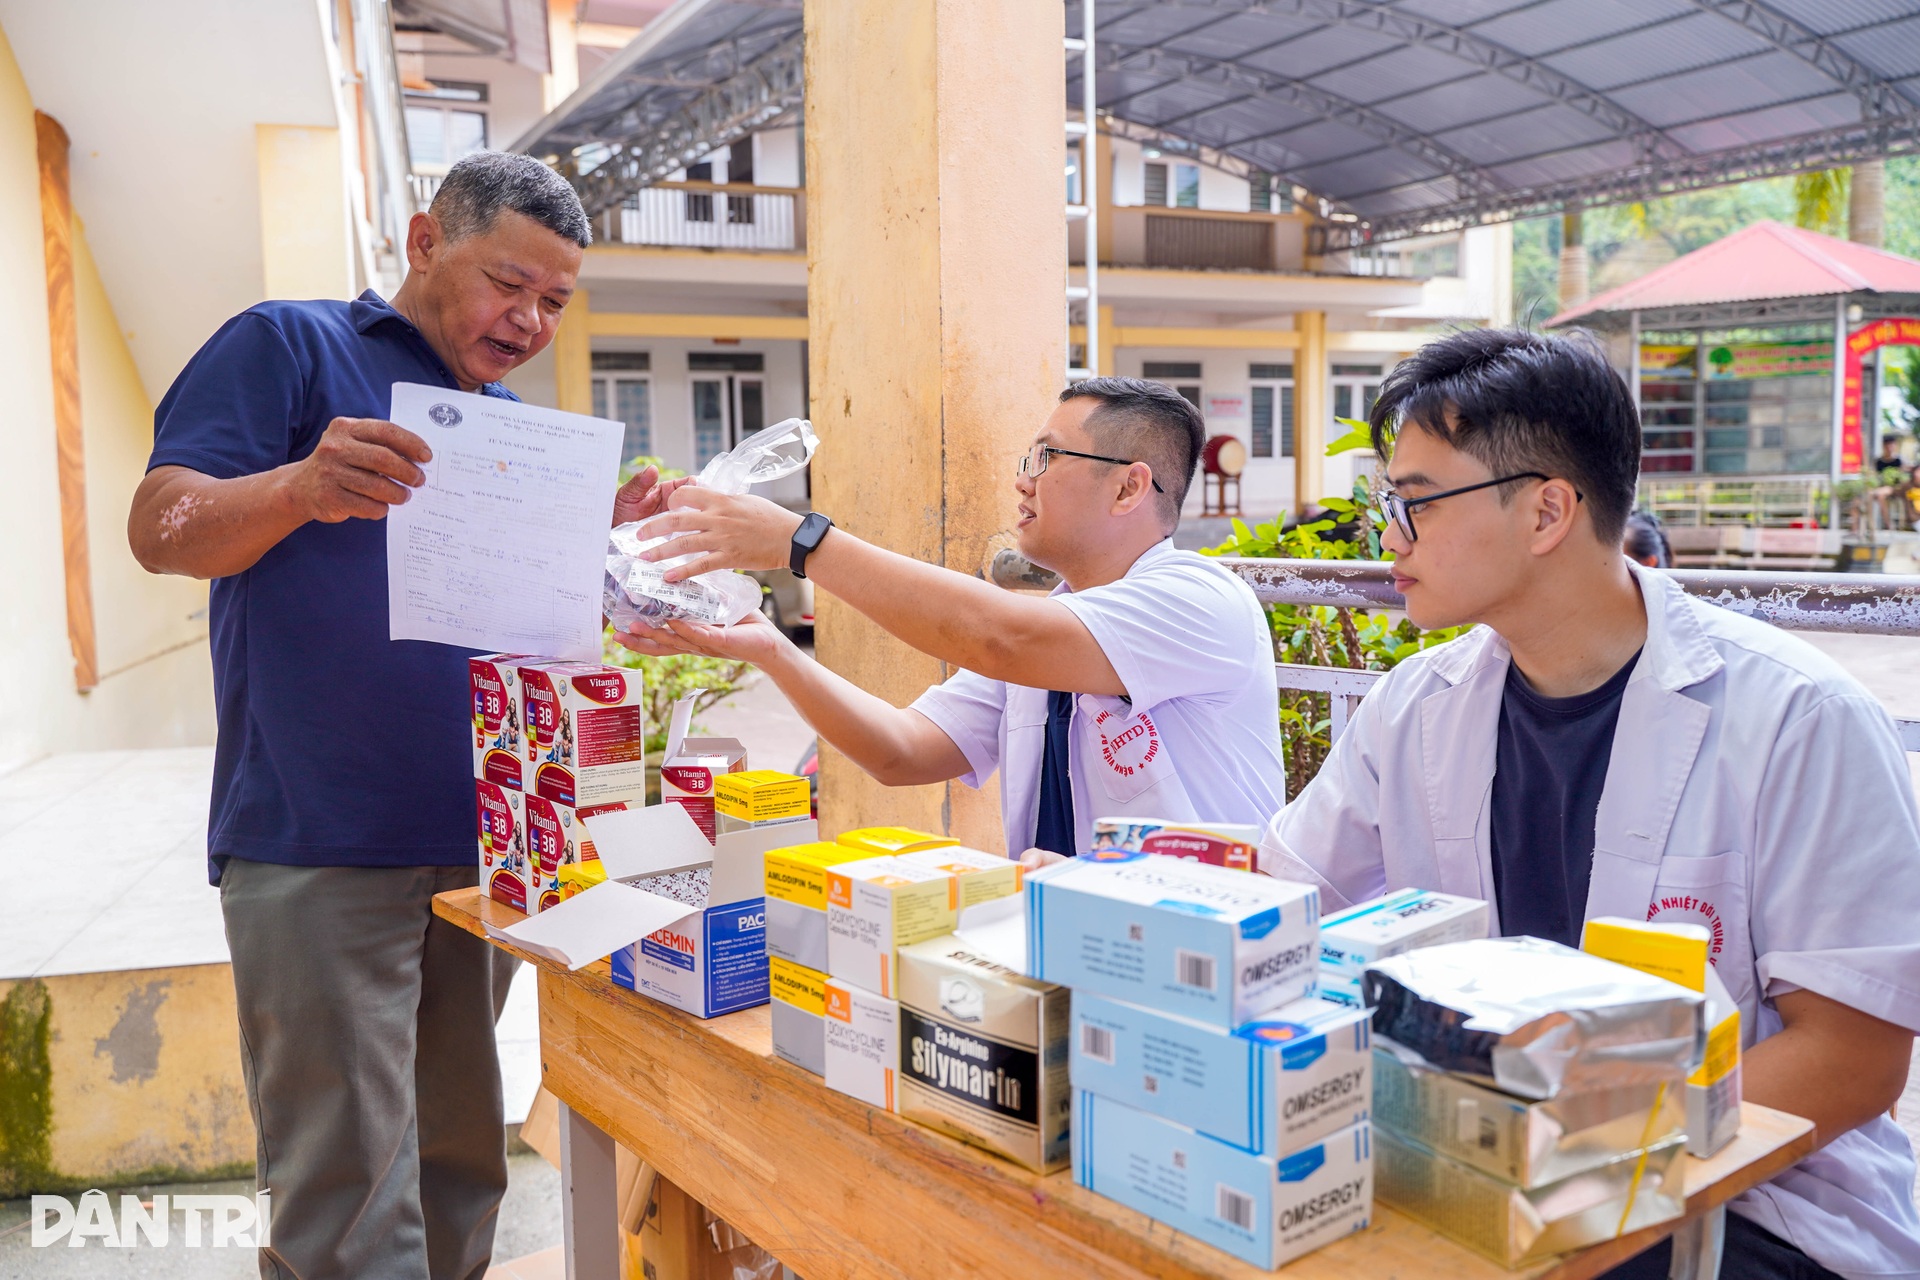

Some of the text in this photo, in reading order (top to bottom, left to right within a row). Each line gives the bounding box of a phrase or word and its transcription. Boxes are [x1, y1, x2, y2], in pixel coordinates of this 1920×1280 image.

[473, 673, 500, 692] Vitamin
[589, 676, 620, 687] Vitamin
[525, 682, 554, 703] Vitamin
[604, 687, 619, 699] 3B
[486, 695, 500, 715] 3B
[538, 705, 553, 726] 3B
[677, 769, 706, 779] Vitamin
[1114, 763, 1134, 777] BỆNH
[691, 779, 705, 789] 3B
[479, 792, 507, 814] Vitamin
[715, 791, 739, 804] AMLODIPIN
[738, 797, 749, 809] 5mg
[493, 816, 507, 836] 3B
[528, 808, 557, 833] Vitamin
[542, 834, 556, 855] 3B
[767, 870, 824, 895] AMLODIPIN 5mg
[737, 912, 767, 930] PAC
[830, 908, 882, 938] DOXYCYCLINE
[1660, 895, 1699, 911] NHIỆT
[1711, 915, 1724, 953] TRUNG
[646, 928, 695, 955] ACEMIN
[1241, 940, 1315, 988] OMSERGY
[773, 972, 810, 994] AMLODIPIN
[828, 1020, 887, 1054] DOXYCYCLINE
[911, 1035, 1022, 1112] Silymarin
[1282, 1066, 1365, 1121] OMSERGY
[1279, 1176, 1365, 1232] OMSERGY
